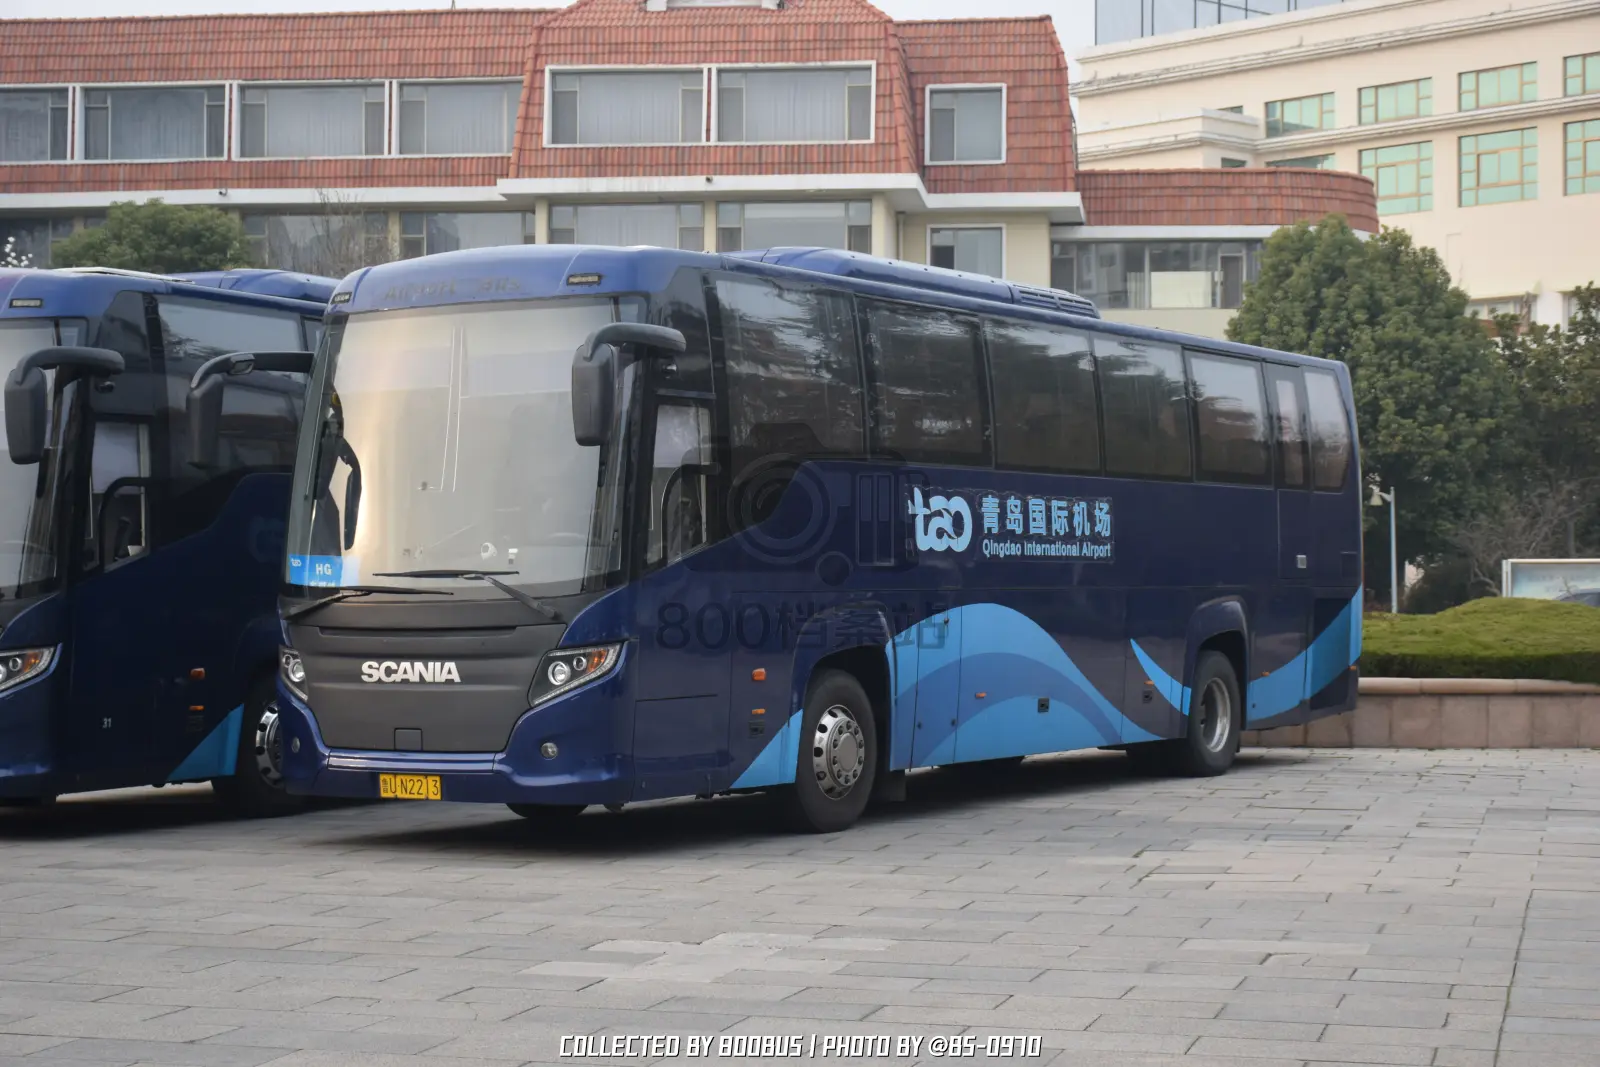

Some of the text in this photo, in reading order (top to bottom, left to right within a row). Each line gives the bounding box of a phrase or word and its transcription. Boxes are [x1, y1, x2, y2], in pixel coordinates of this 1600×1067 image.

[982, 495, 1111, 537] 青岛国际机场
[983, 539, 1111, 559] Qingdao International Airport
[315, 563, 332, 576] HG
[361, 661, 461, 683] SCANIA
